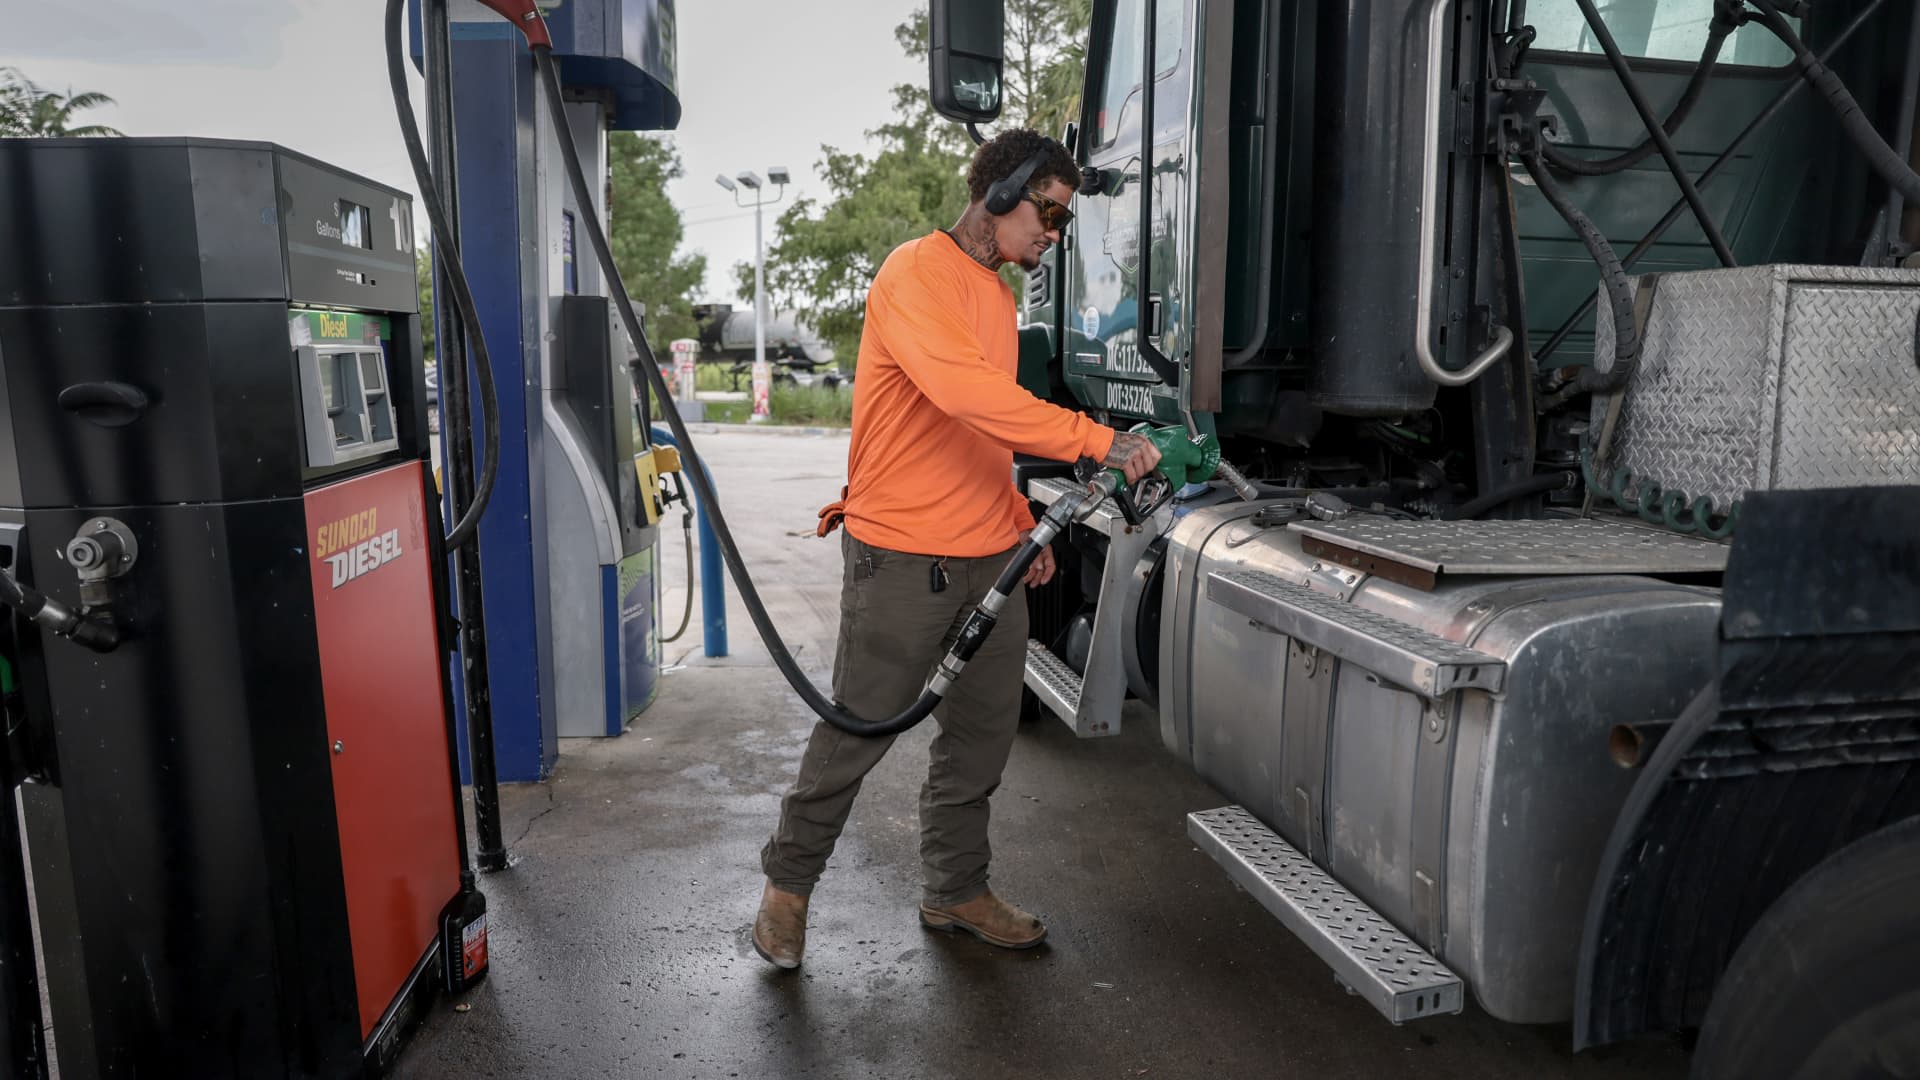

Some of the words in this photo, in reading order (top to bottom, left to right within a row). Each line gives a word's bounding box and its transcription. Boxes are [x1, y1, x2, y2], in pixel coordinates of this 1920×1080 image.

[316, 219, 341, 239] Gallons
[389, 198, 412, 254] 10
[320, 312, 348, 338] Diesel
[316, 506, 377, 559] SUNOCO
[323, 528, 402, 589] DIESEL
